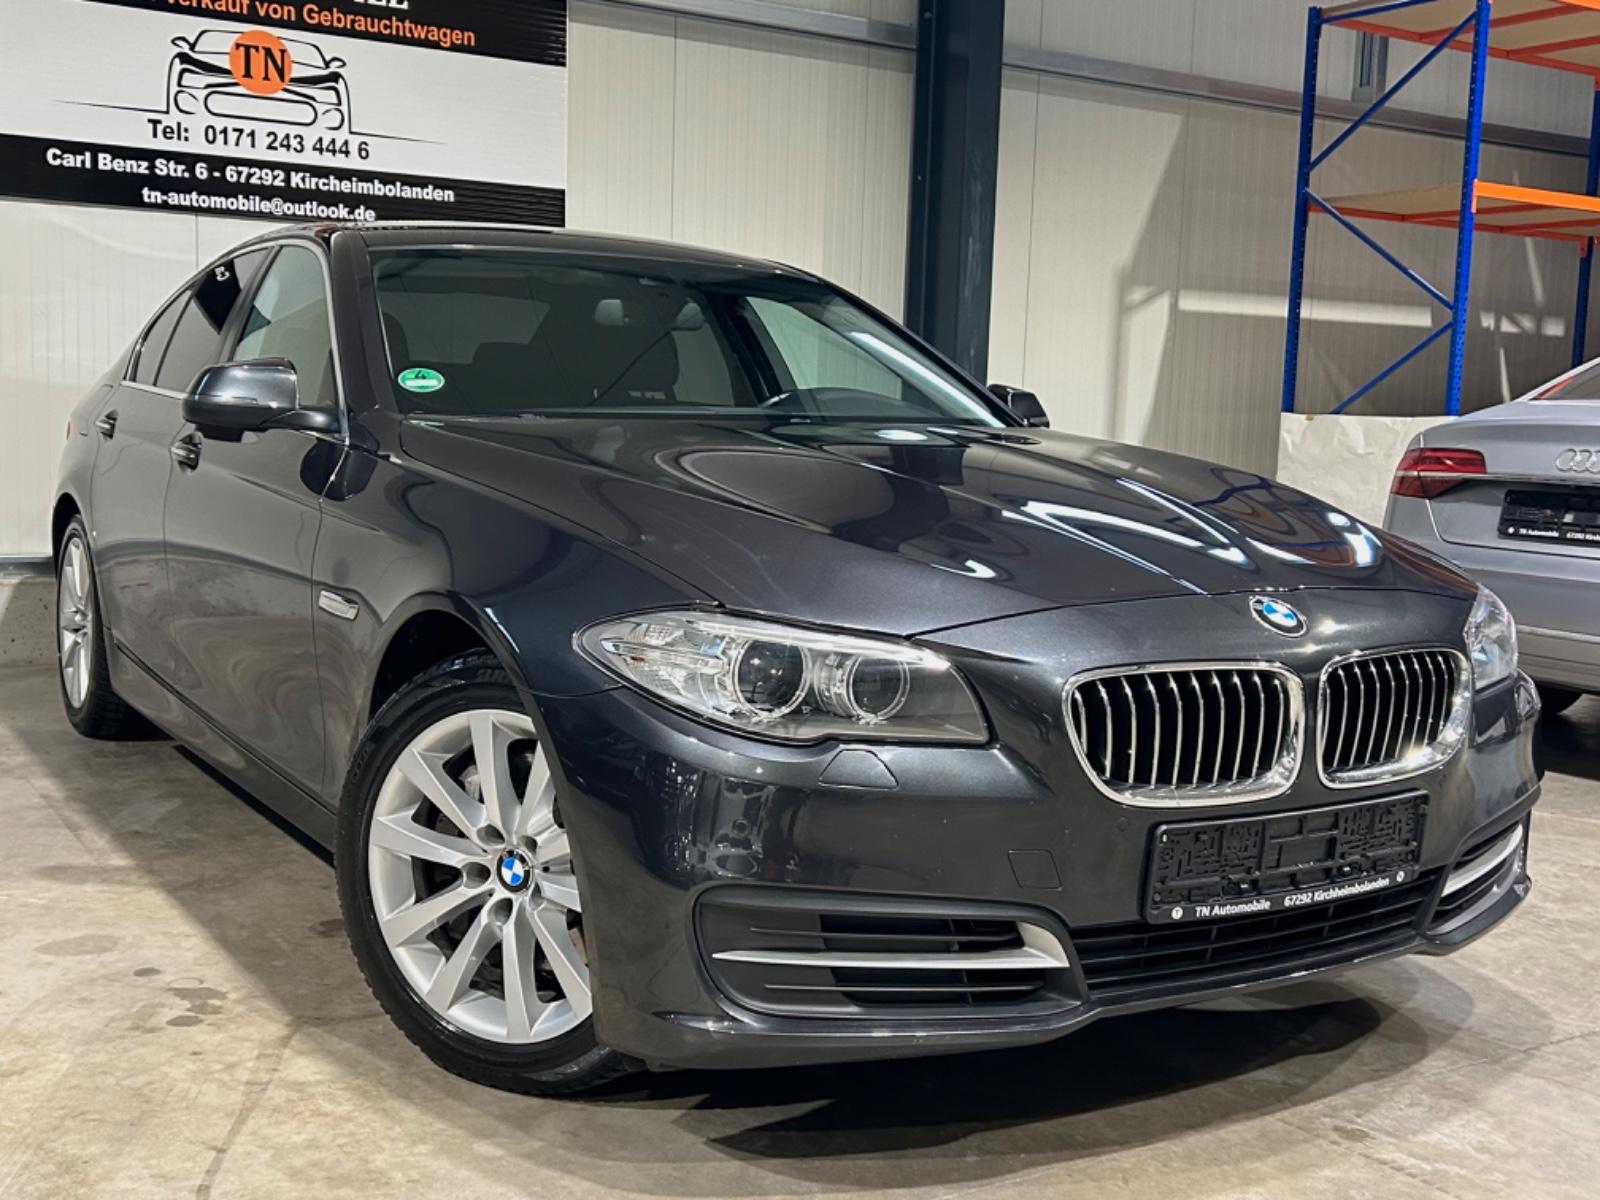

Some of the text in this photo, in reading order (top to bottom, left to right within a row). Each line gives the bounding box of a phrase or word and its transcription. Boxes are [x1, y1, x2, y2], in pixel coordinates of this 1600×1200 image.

[167, 0, 249, 15] rkauf
[255, 1, 296, 21] von
[302, 3, 476, 47] Gebrauchtwagen
[235, 42, 287, 83] TN
[147, 118, 370, 160] Tel: 0171 243 444 6
[46, 147, 91, 169] Carl
[98, 153, 149, 174] Benz
[154, 158, 190, 178] Str.
[195, 162, 208, 179] 6
[225, 165, 285, 187] 67292
[290, 170, 455, 203] Kircheimbolanden
[141, 186, 376, 222] tn-automobile@outlook.de
[1195, 905, 1211, 918] TN
[1211, 899, 1271, 916] Automobile
[1283, 892, 1313, 907] 67292
